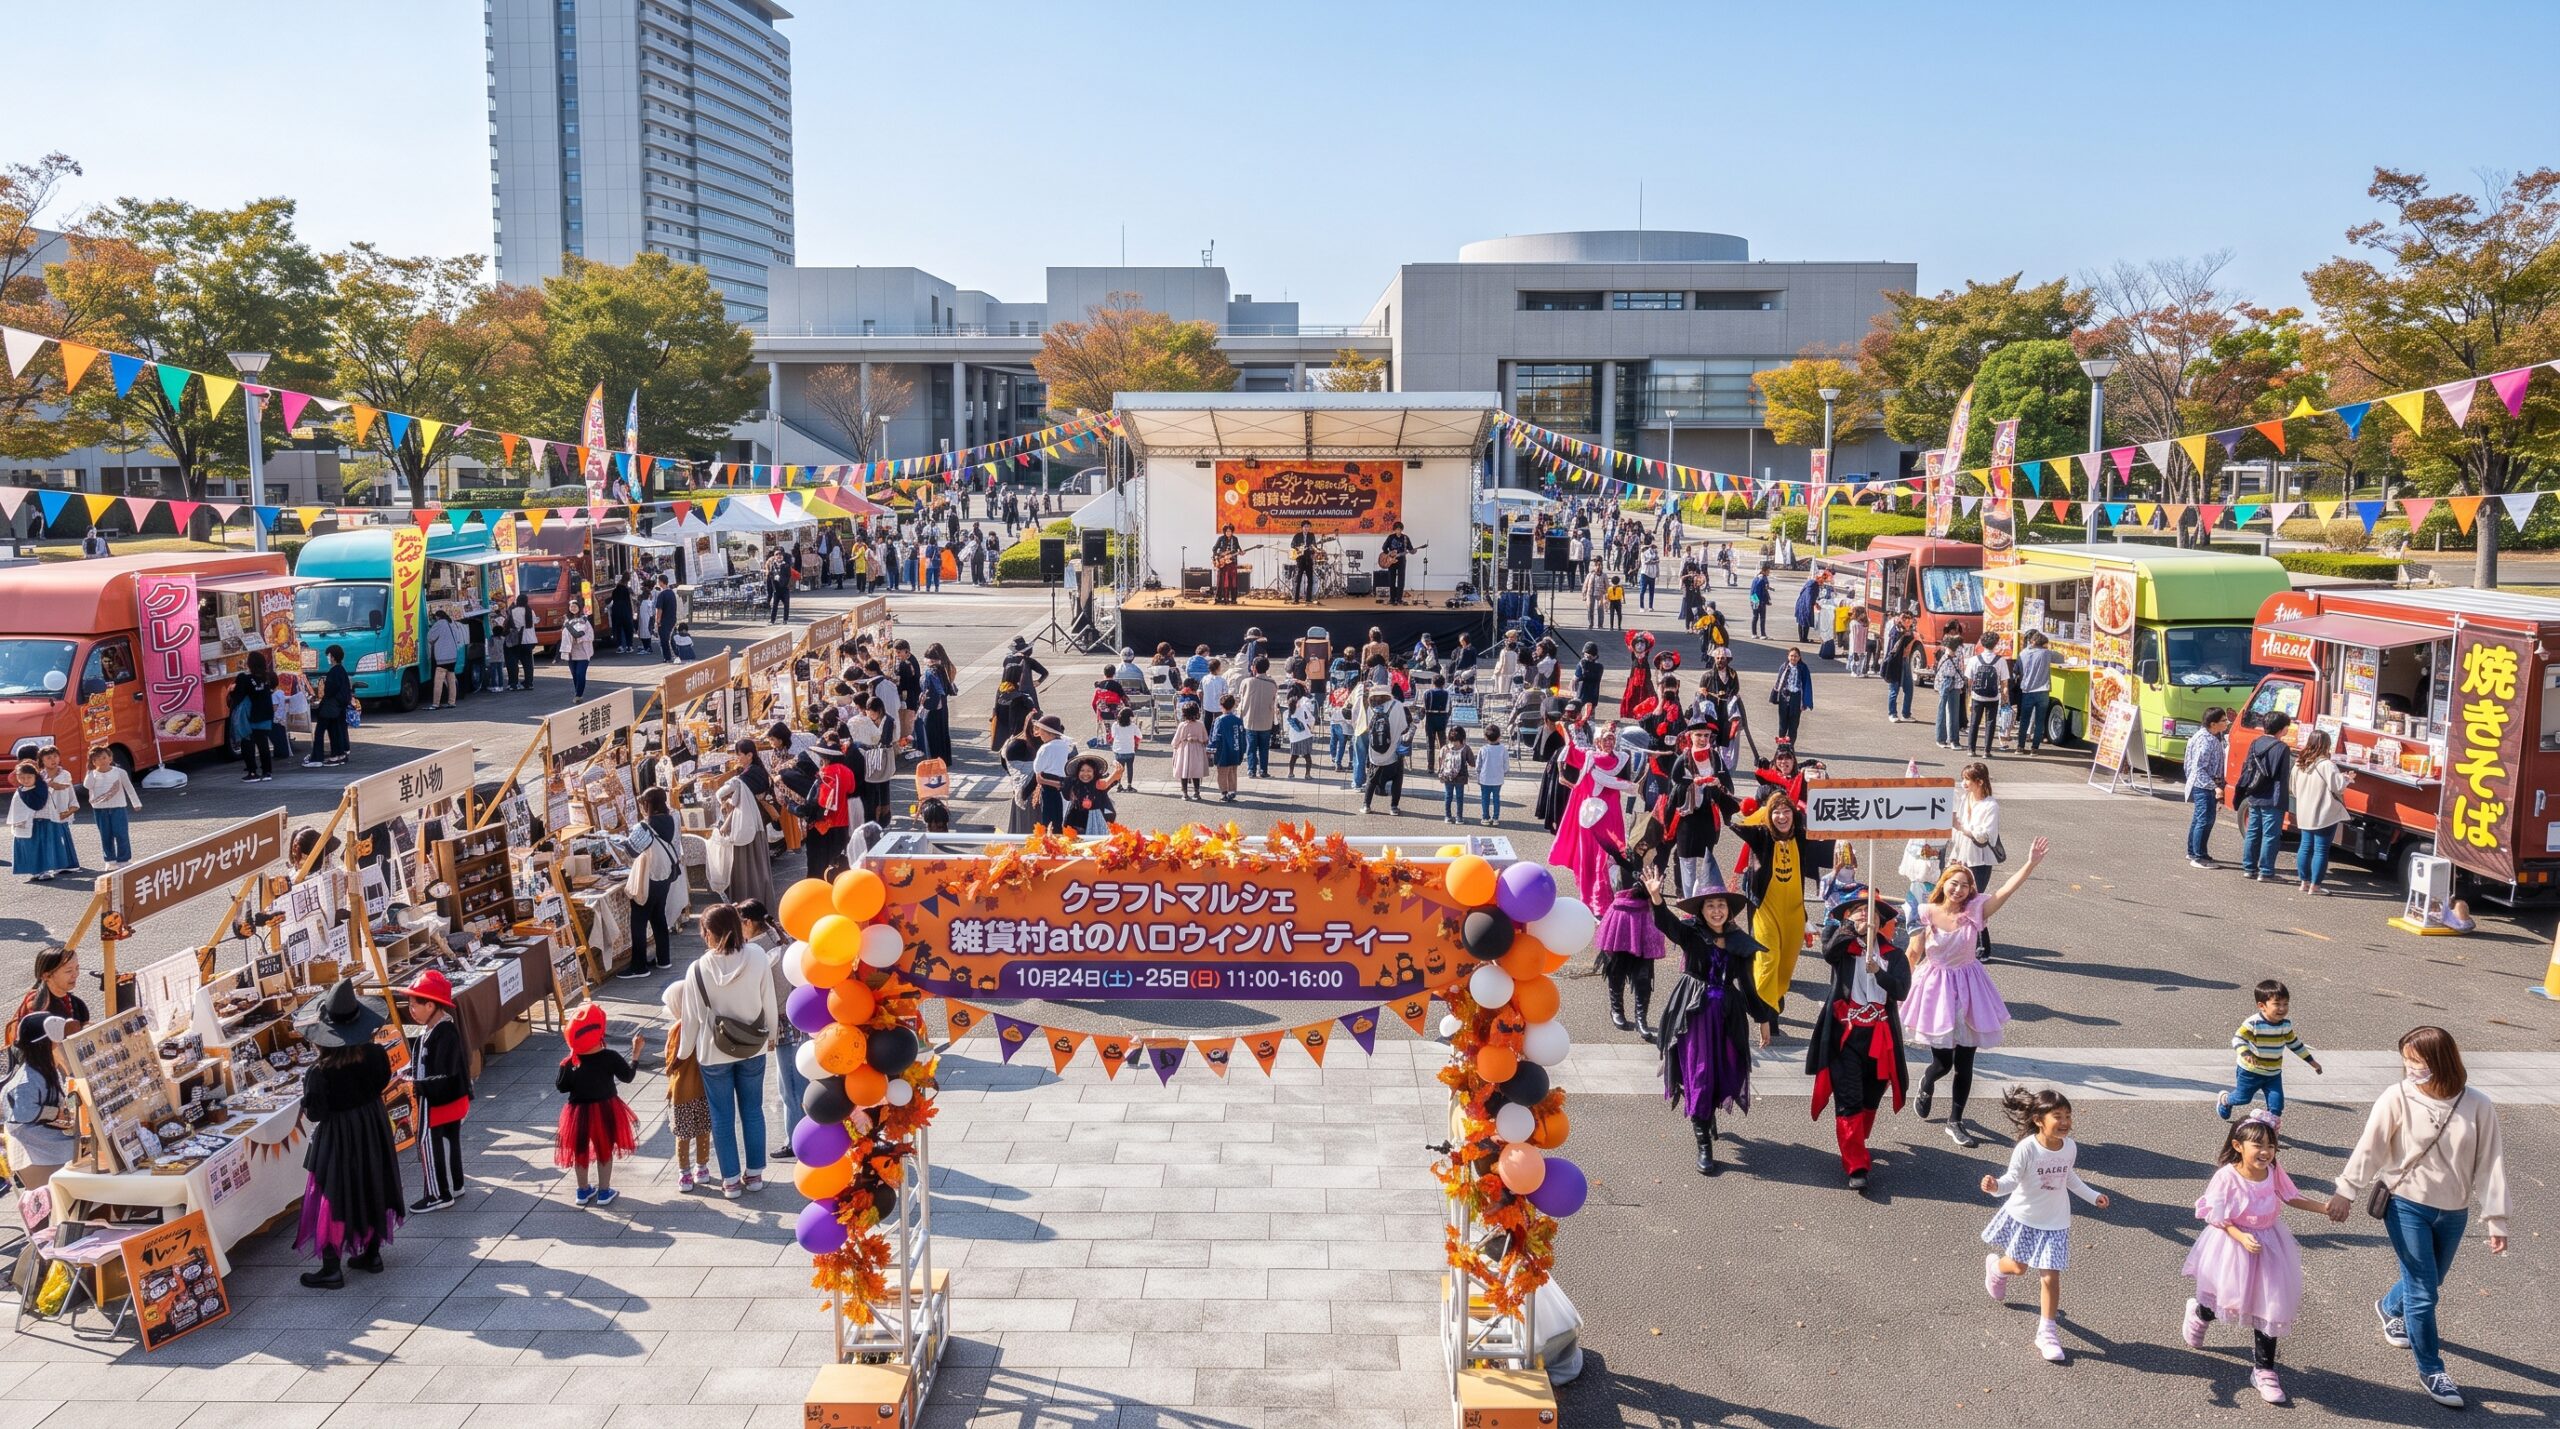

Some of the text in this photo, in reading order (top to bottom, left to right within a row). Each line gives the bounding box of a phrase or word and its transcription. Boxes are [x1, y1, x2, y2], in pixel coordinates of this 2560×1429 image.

[144, 583, 198, 714] クレープ
[2452, 643, 2518, 848] 焼きそば
[398, 762, 443, 804] 革小物
[1812, 797, 1946, 821] 仮装パレード
[134, 832, 274, 905] 手作りアクセサリー
[1062, 882, 1295, 913] クラフトマルシェ
[951, 919, 1410, 954] 雑貨村atのハロウィンパーティー
[1226, 969, 1343, 989] 11:00-16:00
